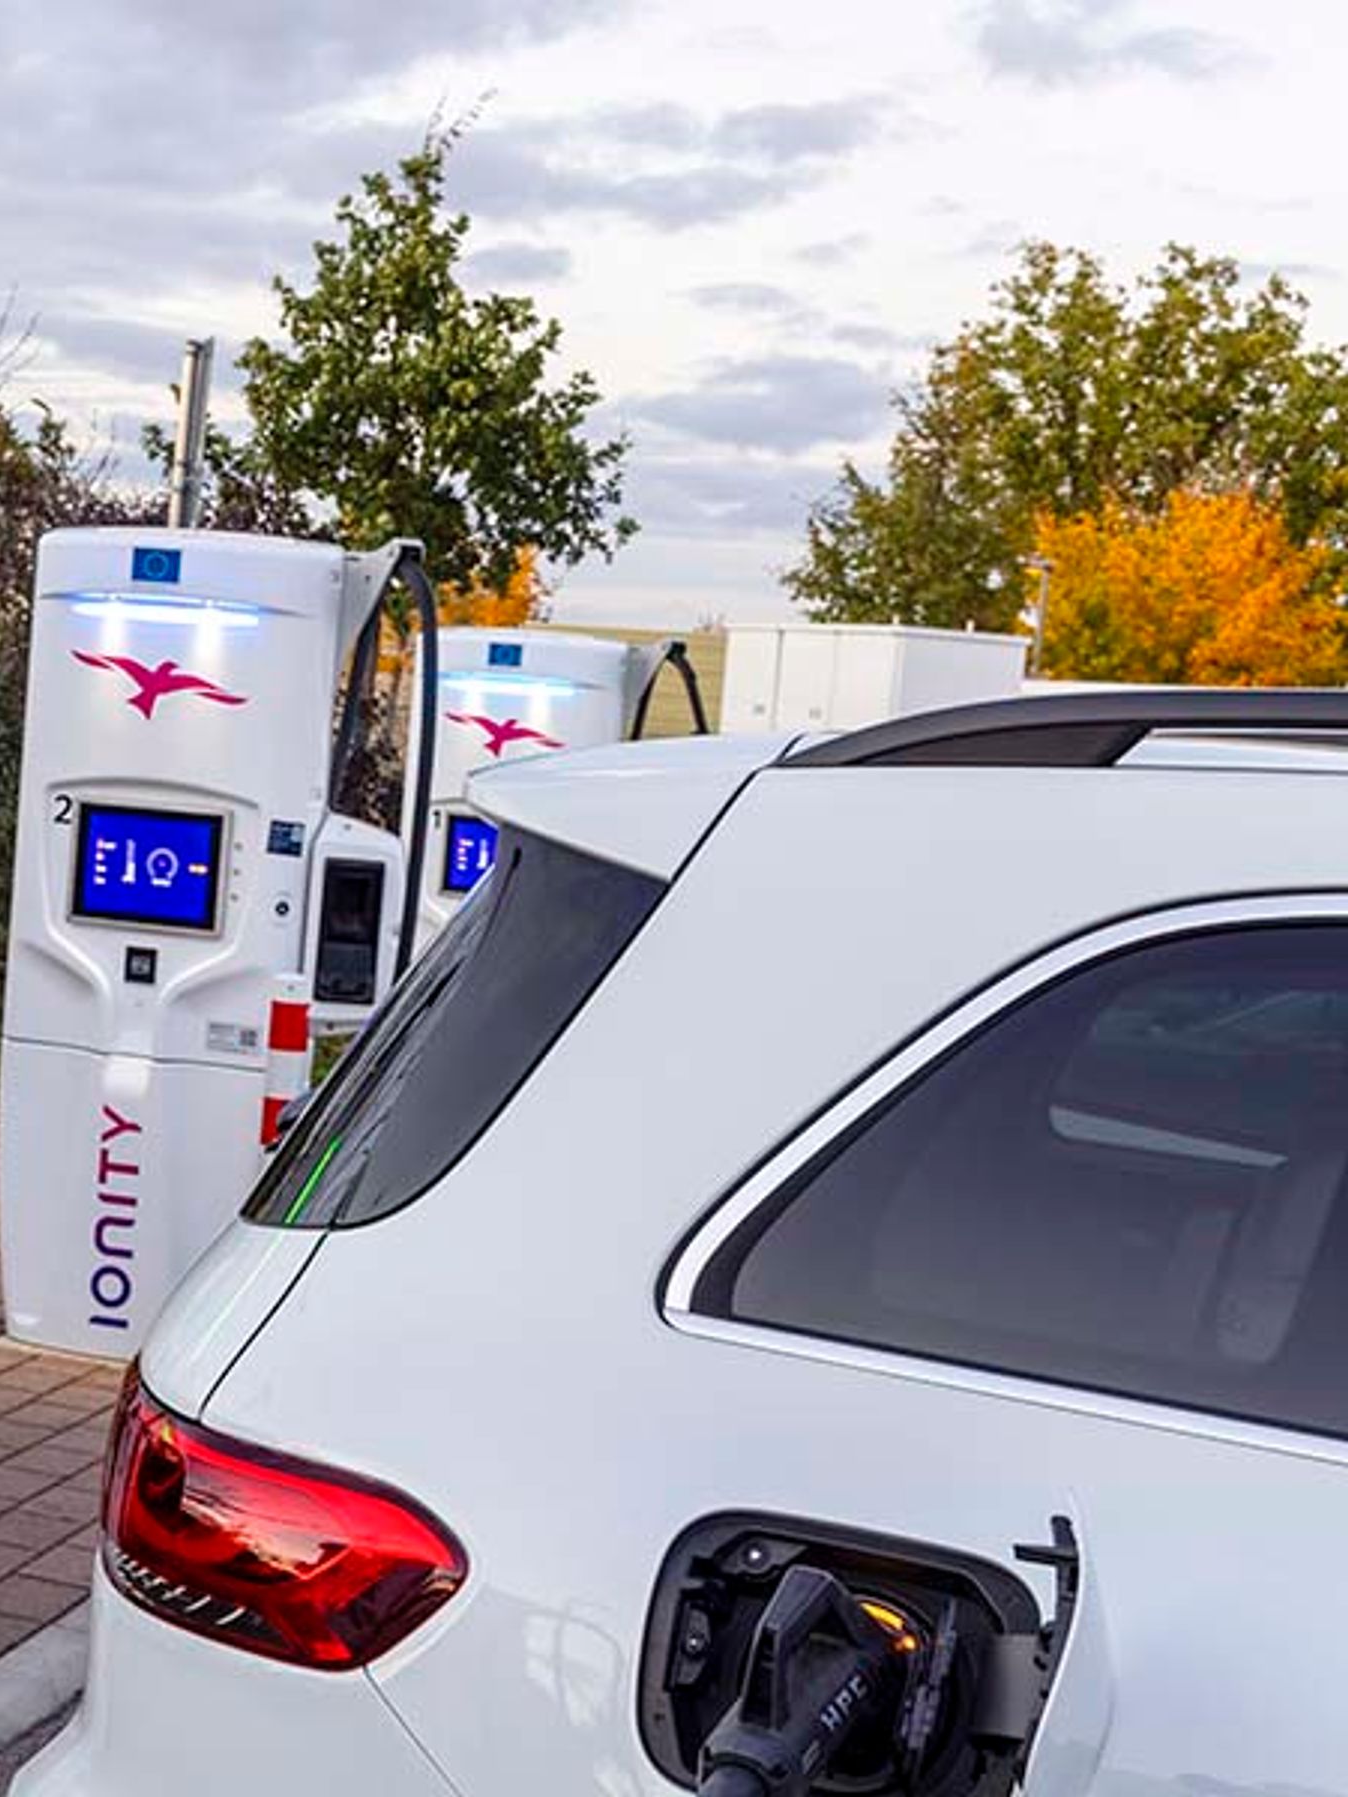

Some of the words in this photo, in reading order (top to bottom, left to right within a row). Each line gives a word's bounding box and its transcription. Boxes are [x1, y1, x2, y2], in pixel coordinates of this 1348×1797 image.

[54, 794, 73, 825] 2
[89, 1105, 142, 1329] IONITY
[820, 1675, 867, 1731] HPC
